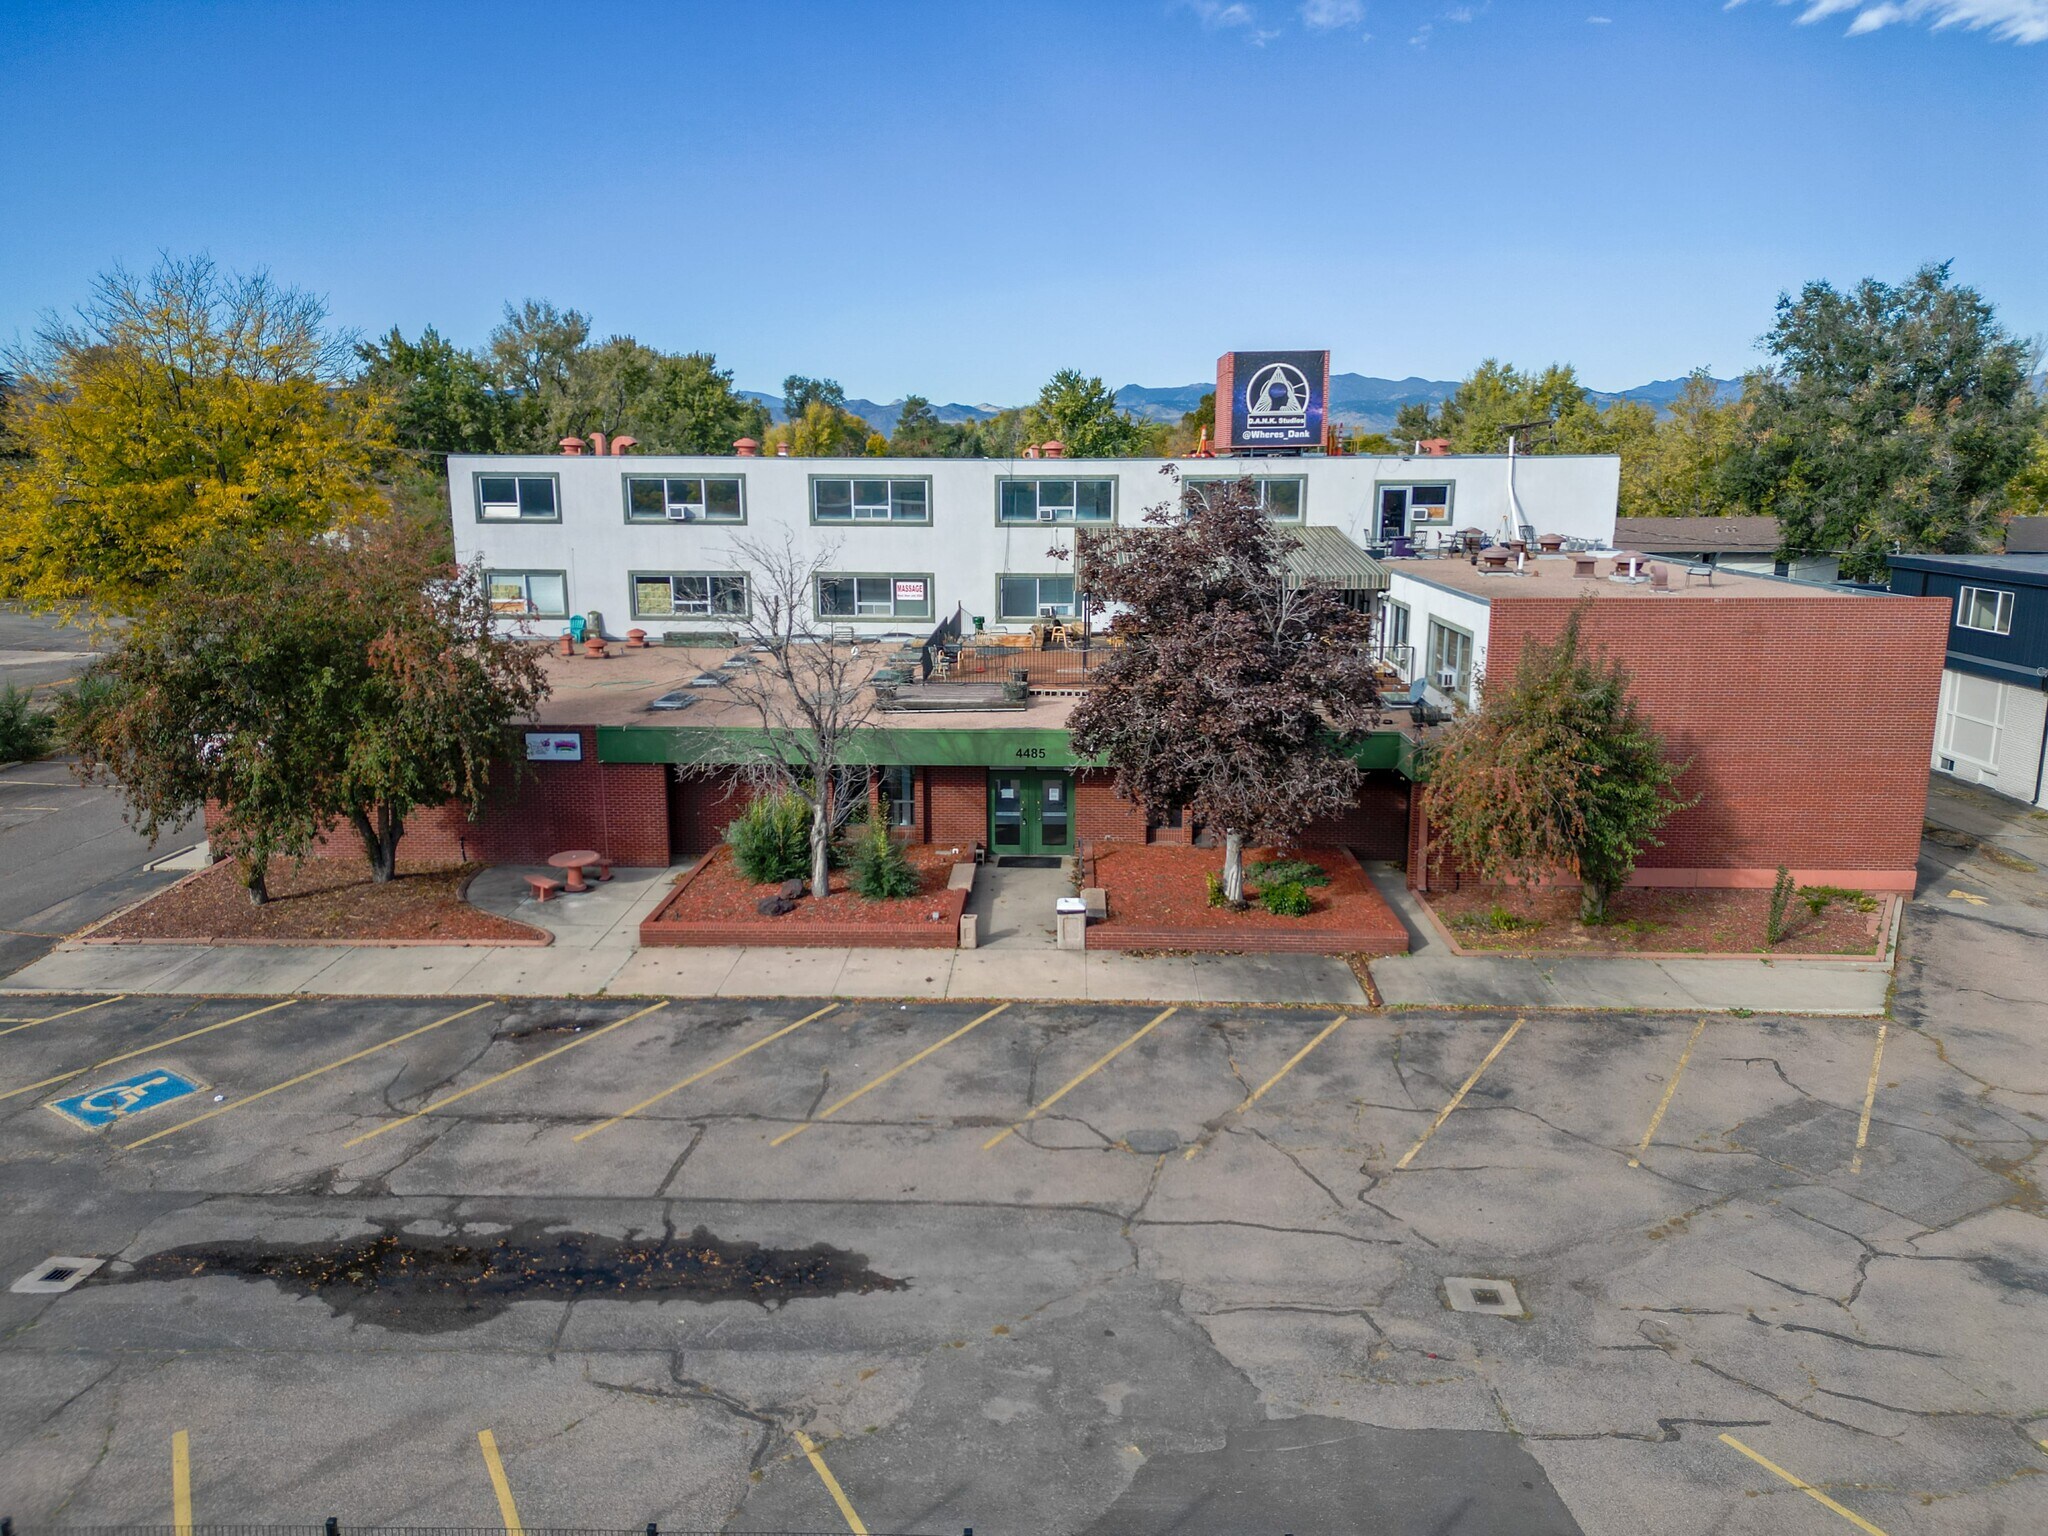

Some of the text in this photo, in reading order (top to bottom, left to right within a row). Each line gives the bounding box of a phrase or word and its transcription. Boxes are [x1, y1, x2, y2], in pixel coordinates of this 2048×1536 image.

[1242, 430, 1310, 440] @Wheres_Dank
[897, 584, 923, 593] MASSAGE
[1015, 748, 1046, 759] 4485
